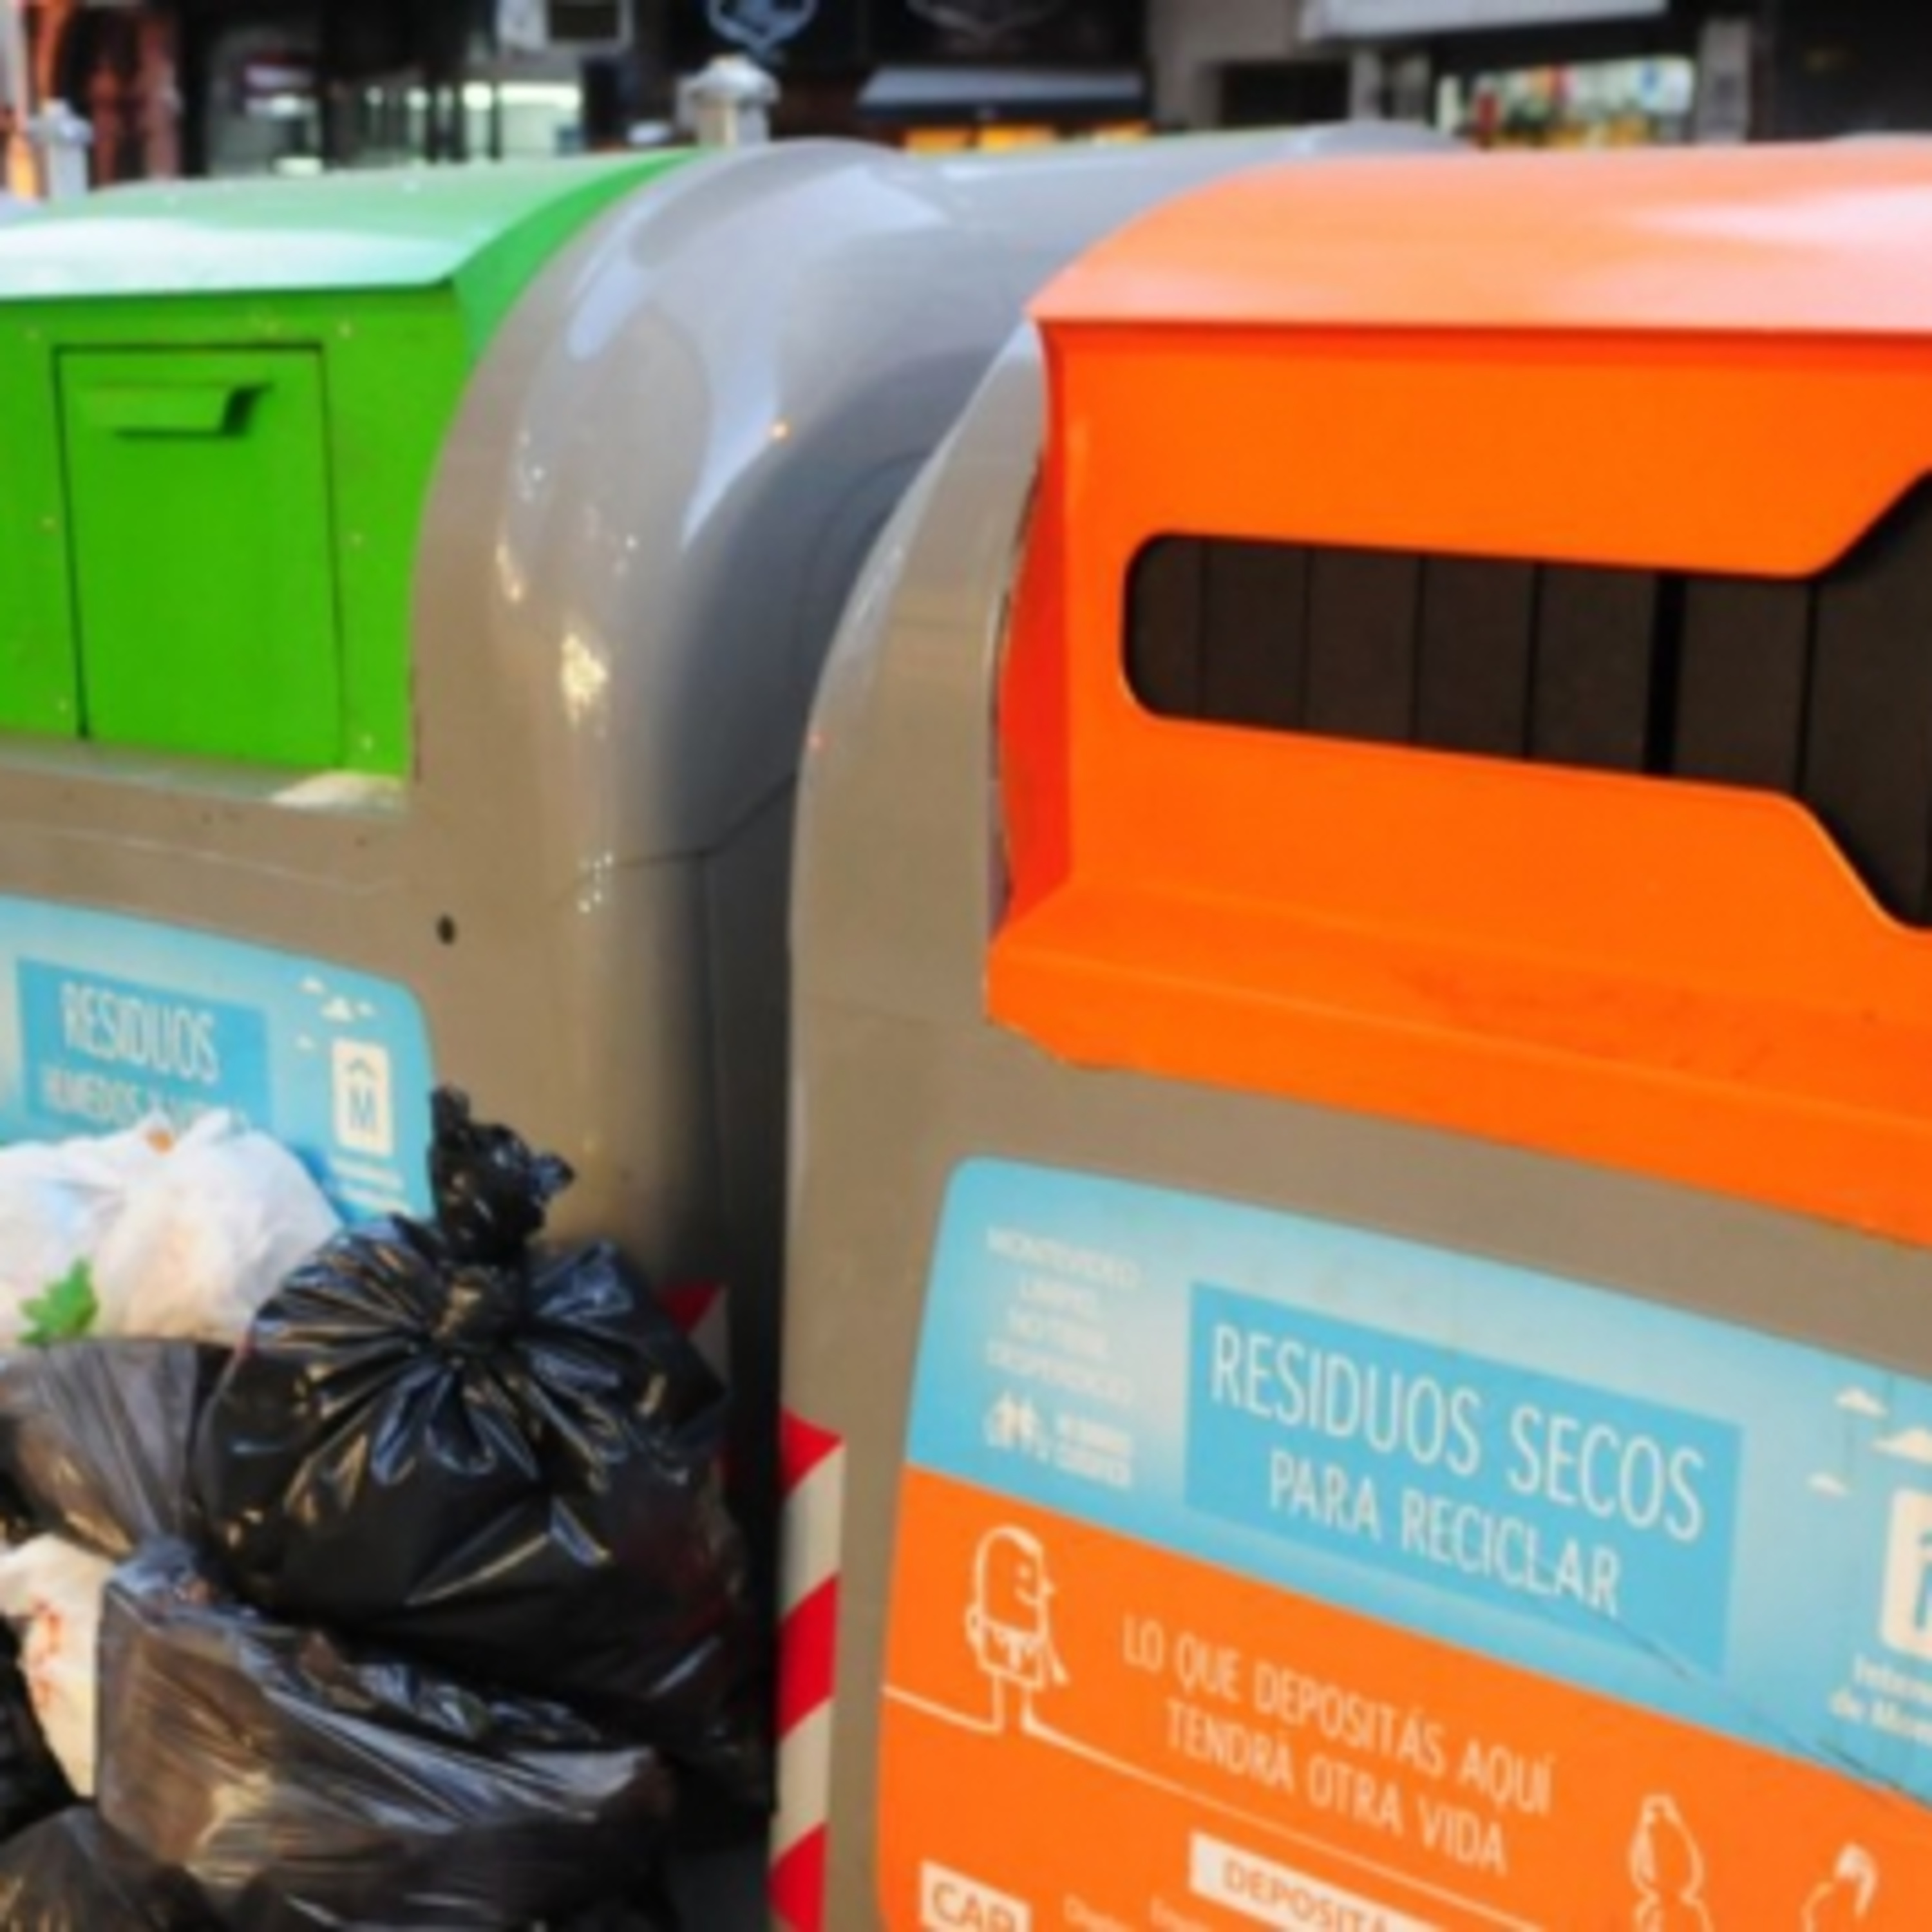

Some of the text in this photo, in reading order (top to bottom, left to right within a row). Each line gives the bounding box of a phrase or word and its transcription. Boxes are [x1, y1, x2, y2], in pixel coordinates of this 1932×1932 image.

[61, 980, 220, 1086] RESIDUOS
[1212, 1323, 1705, 1542] RESIDUOS SECOS
[1269, 1449, 1620, 1618] PARA RECICLAR
[1122, 1614, 1163, 1673] LO
[1175, 1631, 1240, 1703] QUE
[1254, 1658, 1446, 1780] DEPOSITÁS
[1309, 1752, 1404, 1838] OTRA
[1418, 1793, 1508, 1877] VIDA
